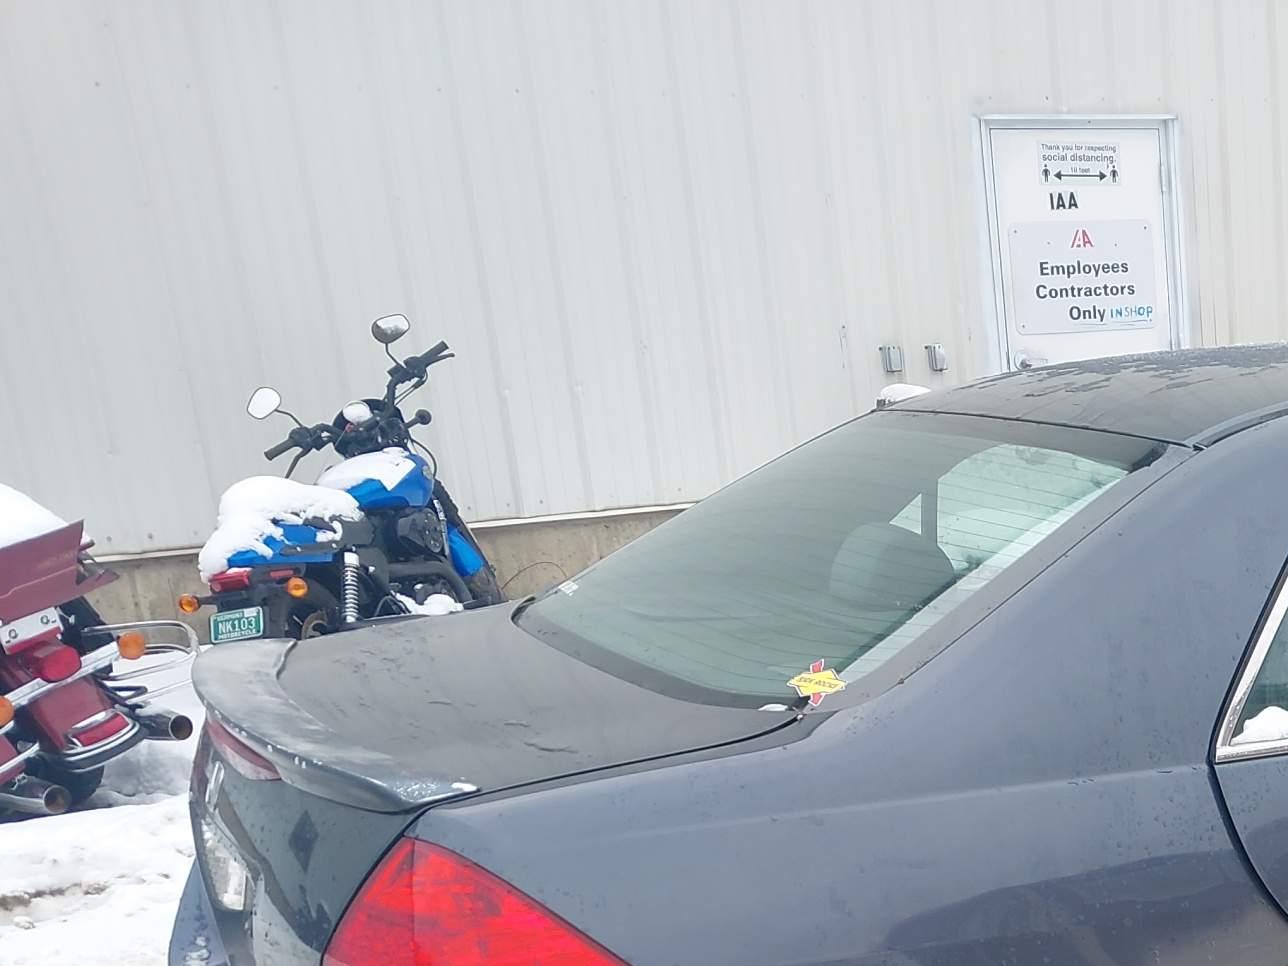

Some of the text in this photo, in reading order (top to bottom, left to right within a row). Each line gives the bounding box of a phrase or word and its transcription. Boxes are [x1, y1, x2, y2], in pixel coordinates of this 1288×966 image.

[1041, 143, 1117, 153] Thank you for respecting
[1042, 153, 1117, 164] social distancing.
[1050, 192, 1079, 210] IAA
[1040, 260, 1129, 278] Employees
[1036, 284, 1136, 299] Contractors
[1069, 305, 1106, 322] Only
[218, 617, 256, 634] NK103
